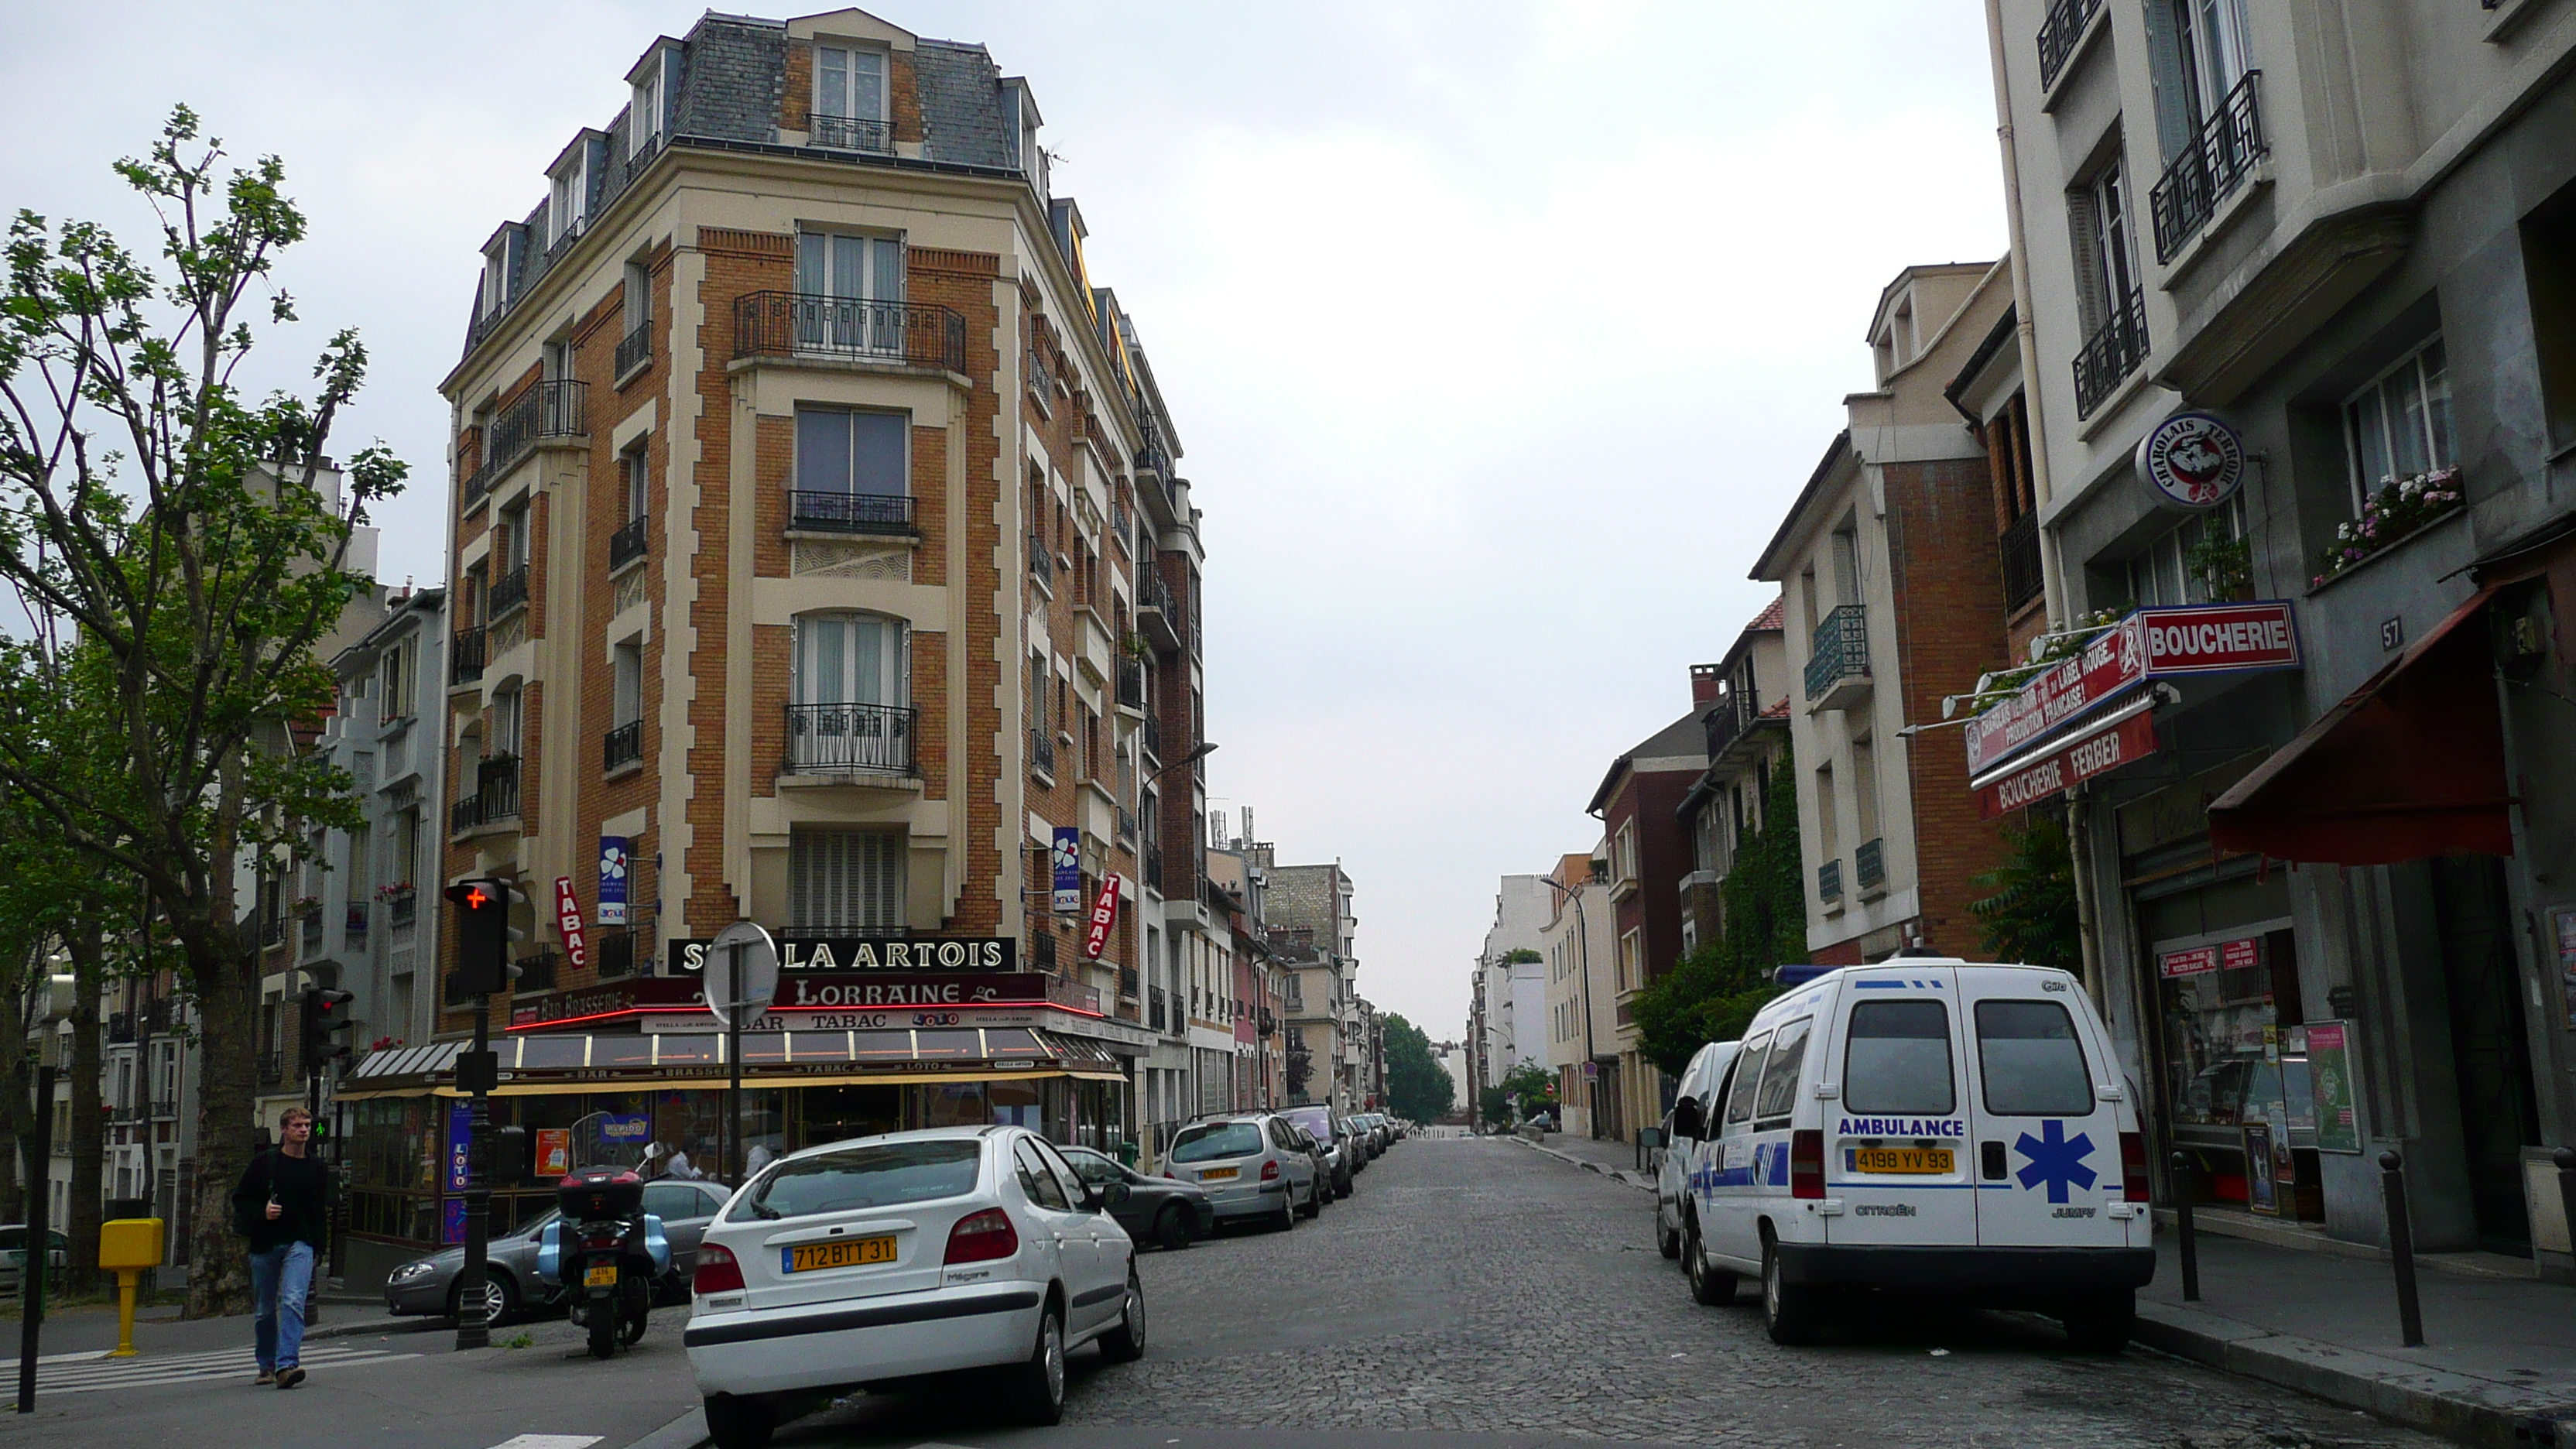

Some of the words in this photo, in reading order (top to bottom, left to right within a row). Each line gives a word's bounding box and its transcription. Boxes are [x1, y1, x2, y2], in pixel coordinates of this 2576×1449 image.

[2153, 420, 2195, 488] CHAROLAIS
[2208, 424, 2239, 485] TERROIR
[2149, 620, 2289, 656] BOUCHERIE
[2383, 620, 2399, 646] 57
[2057, 660, 2081, 690] LABEL
[2006, 710, 2043, 746] PRODUCTION
[1999, 760, 2063, 810] BOUCHERIE
[2070, 731, 2120, 777] FERBER
[559, 880, 584, 965] TABAC
[1088, 876, 1118, 955] TABAC
[684, 943, 836, 968] SLA
[851, 942, 1002, 967] ARTOIS
[542, 999, 561, 1020] BAR
[566, 992, 622, 1018] BRASSERIE
[796, 979, 960, 1005] LORRAINE
[811, 1014, 886, 1028] TABAC
[912, 1012, 960, 1027] LOTO
[577, 1070, 608, 1078] BAR
[666, 1067, 745, 1077] BRASSERE
[804, 1064, 851, 1073] TABAC
[906, 1062, 940, 1070] LOTO
[1838, 1118, 1964, 1136] AMBULANCE
[454, 1143, 468, 1187] LOTO
[1859, 1153, 1897, 1168] 4198
[1903, 1153, 1922, 1168] YV
[1928, 1153, 1949, 1169] 93
[1855, 1204, 1917, 1217] CITROËN
[2051, 1208, 2097, 1218] JUMPY
[795, 1247, 828, 1269] 712
[832, 1243, 865, 1264] BTT
[870, 1241, 890, 1260] 31
